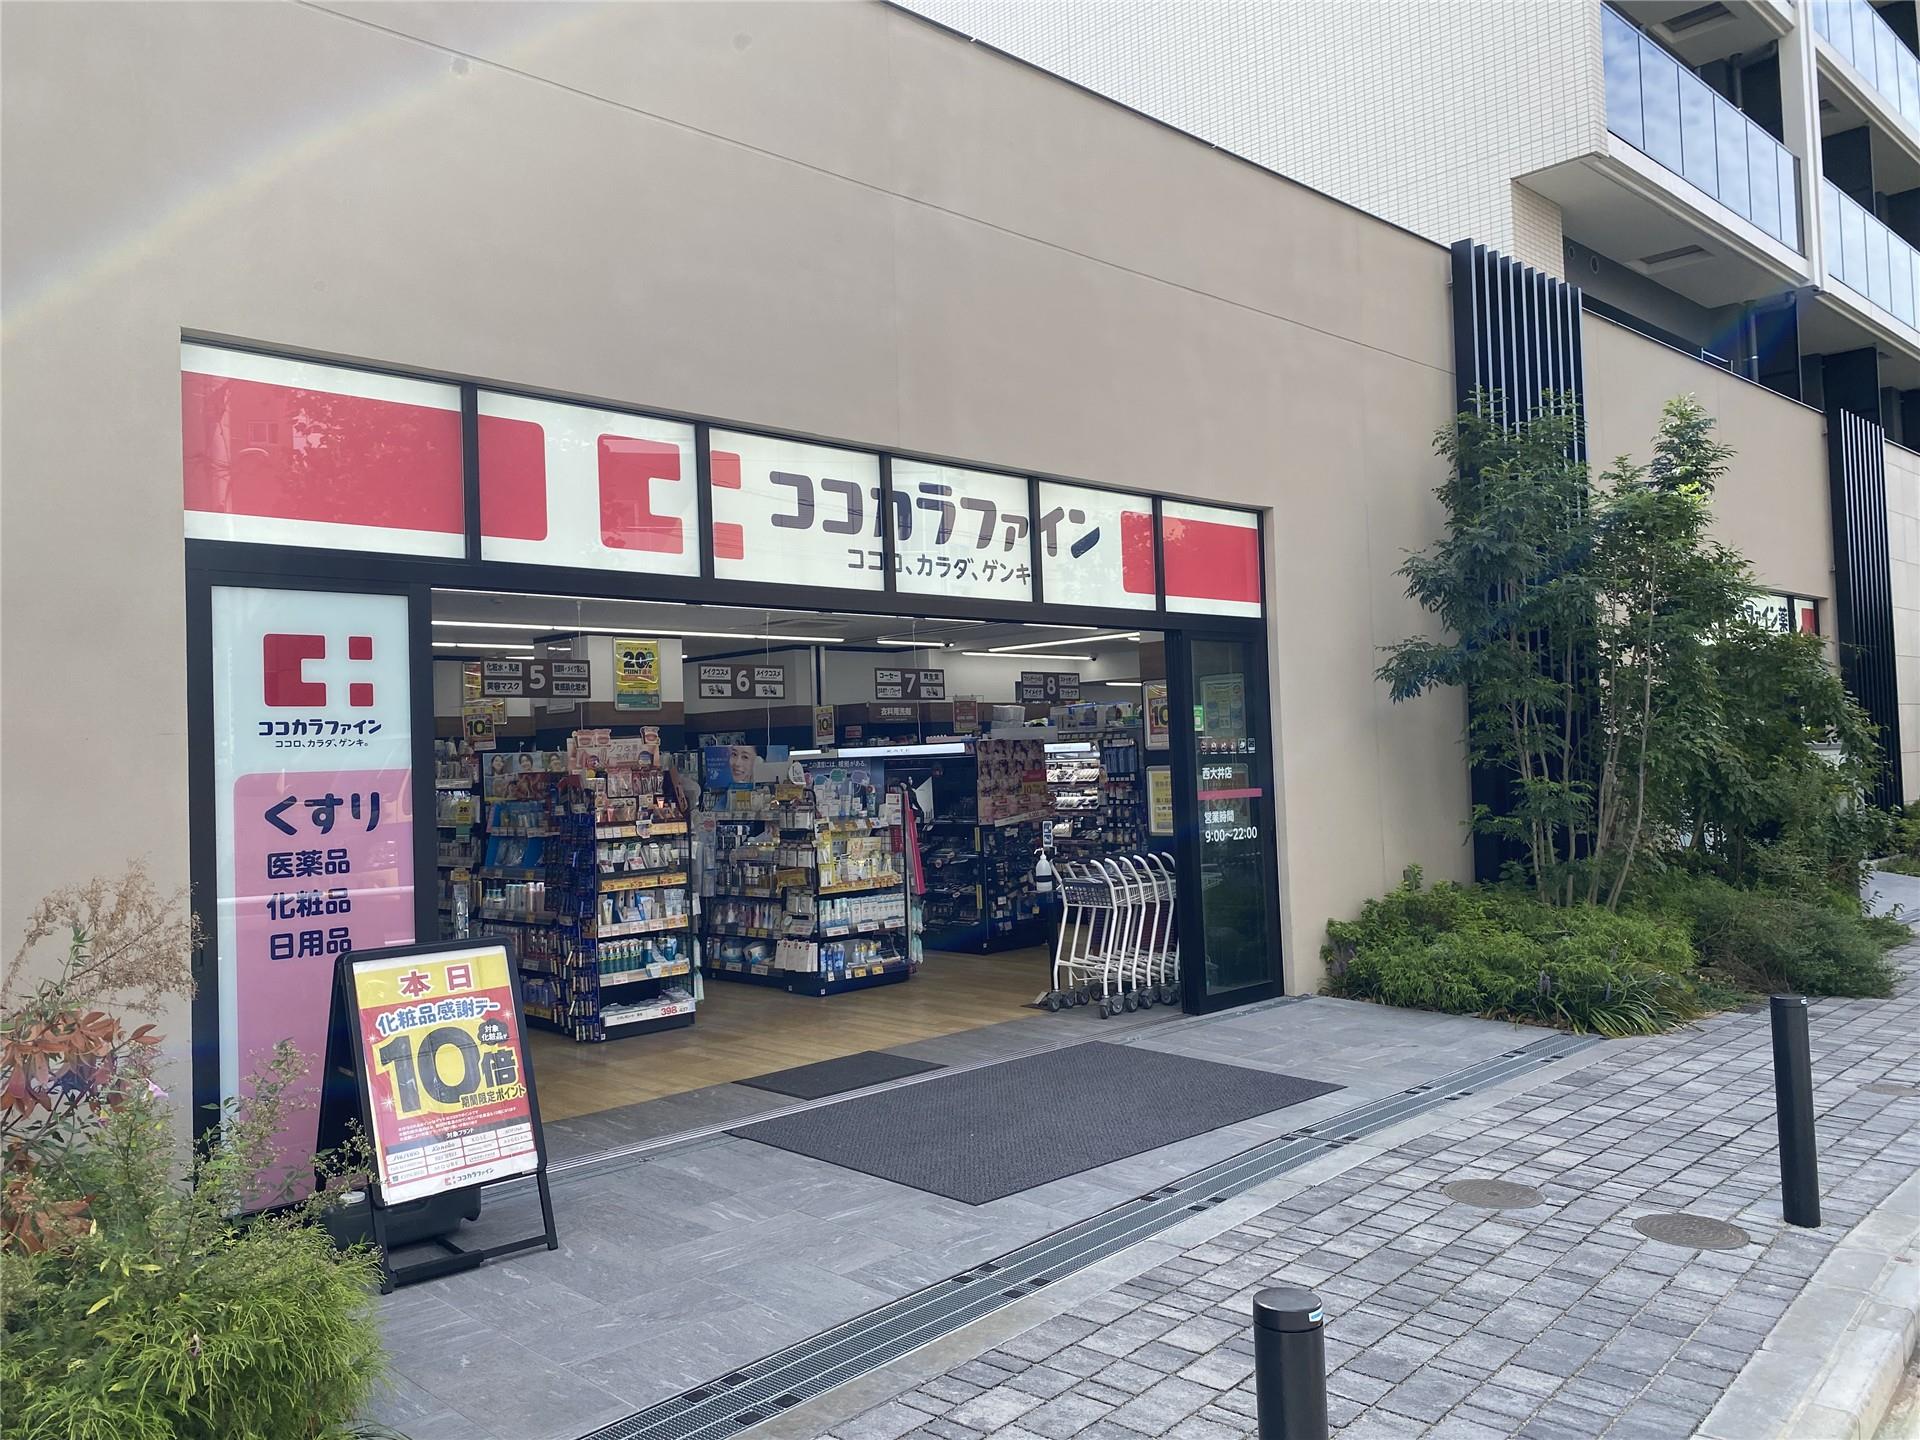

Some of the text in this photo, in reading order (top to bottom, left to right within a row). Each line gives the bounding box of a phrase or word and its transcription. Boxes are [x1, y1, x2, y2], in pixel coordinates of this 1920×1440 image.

[769, 470, 1101, 559] ココカラファイン
[529, 665, 546, 690] 5
[702, 668, 729, 676] メイクコスメ
[736, 670, 750, 692] 6
[904, 673, 916, 693] 7
[1047, 676, 1056, 695] 8
[258, 718, 382, 736] ココカラファイン
[275, 738, 369, 748] ココロ、カラダ、ゲンキ。
[1202, 767, 1233, 780] 西大井店
[264, 791, 381, 836] くすり
[1203, 810, 1235, 824] 営業時間
[267, 848, 351, 879] 医薬品
[266, 887, 352, 921] 化粧品
[270, 926, 352, 961] 日用品
[377, 999, 499, 1034] 化粧品感謝デー
[660, 1005, 678, 1016] 398
[461, 1085, 526, 1108] 期間限定ポイント
[457, 1168, 494, 1182] ココカラファイン
